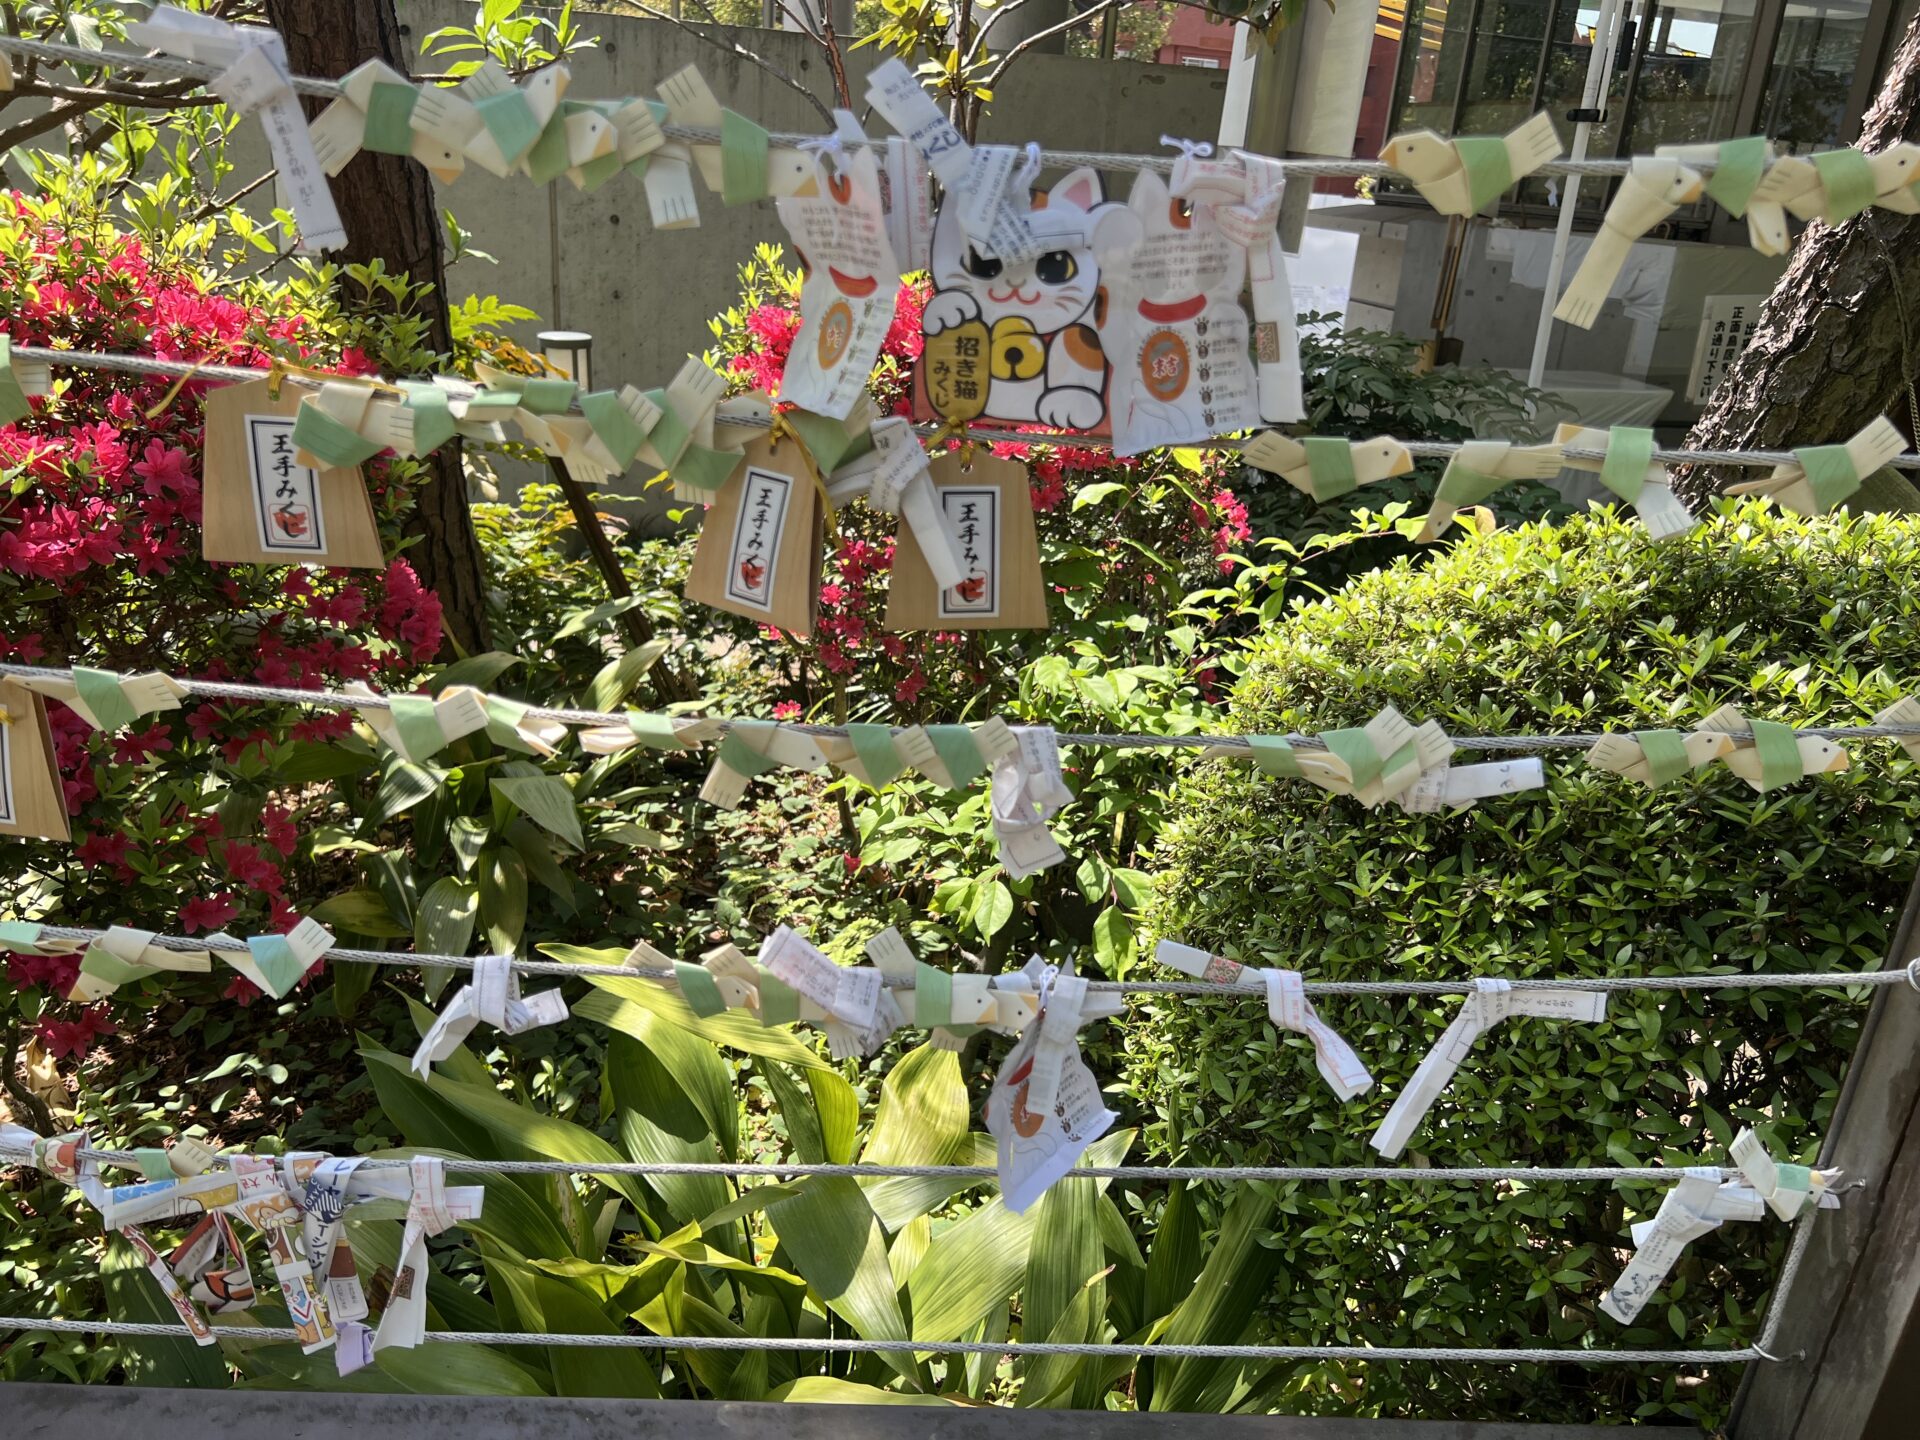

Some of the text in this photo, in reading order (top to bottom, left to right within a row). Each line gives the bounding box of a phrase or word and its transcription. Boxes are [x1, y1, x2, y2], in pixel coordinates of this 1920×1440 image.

[933, 361, 951, 408] みくじ
[954, 336, 980, 400] 招き猫
[1700, 320, 1726, 398] お通り下さい
[271, 433, 300, 539] 王手みくじ
[745, 487, 772, 590] 王手みくじ
